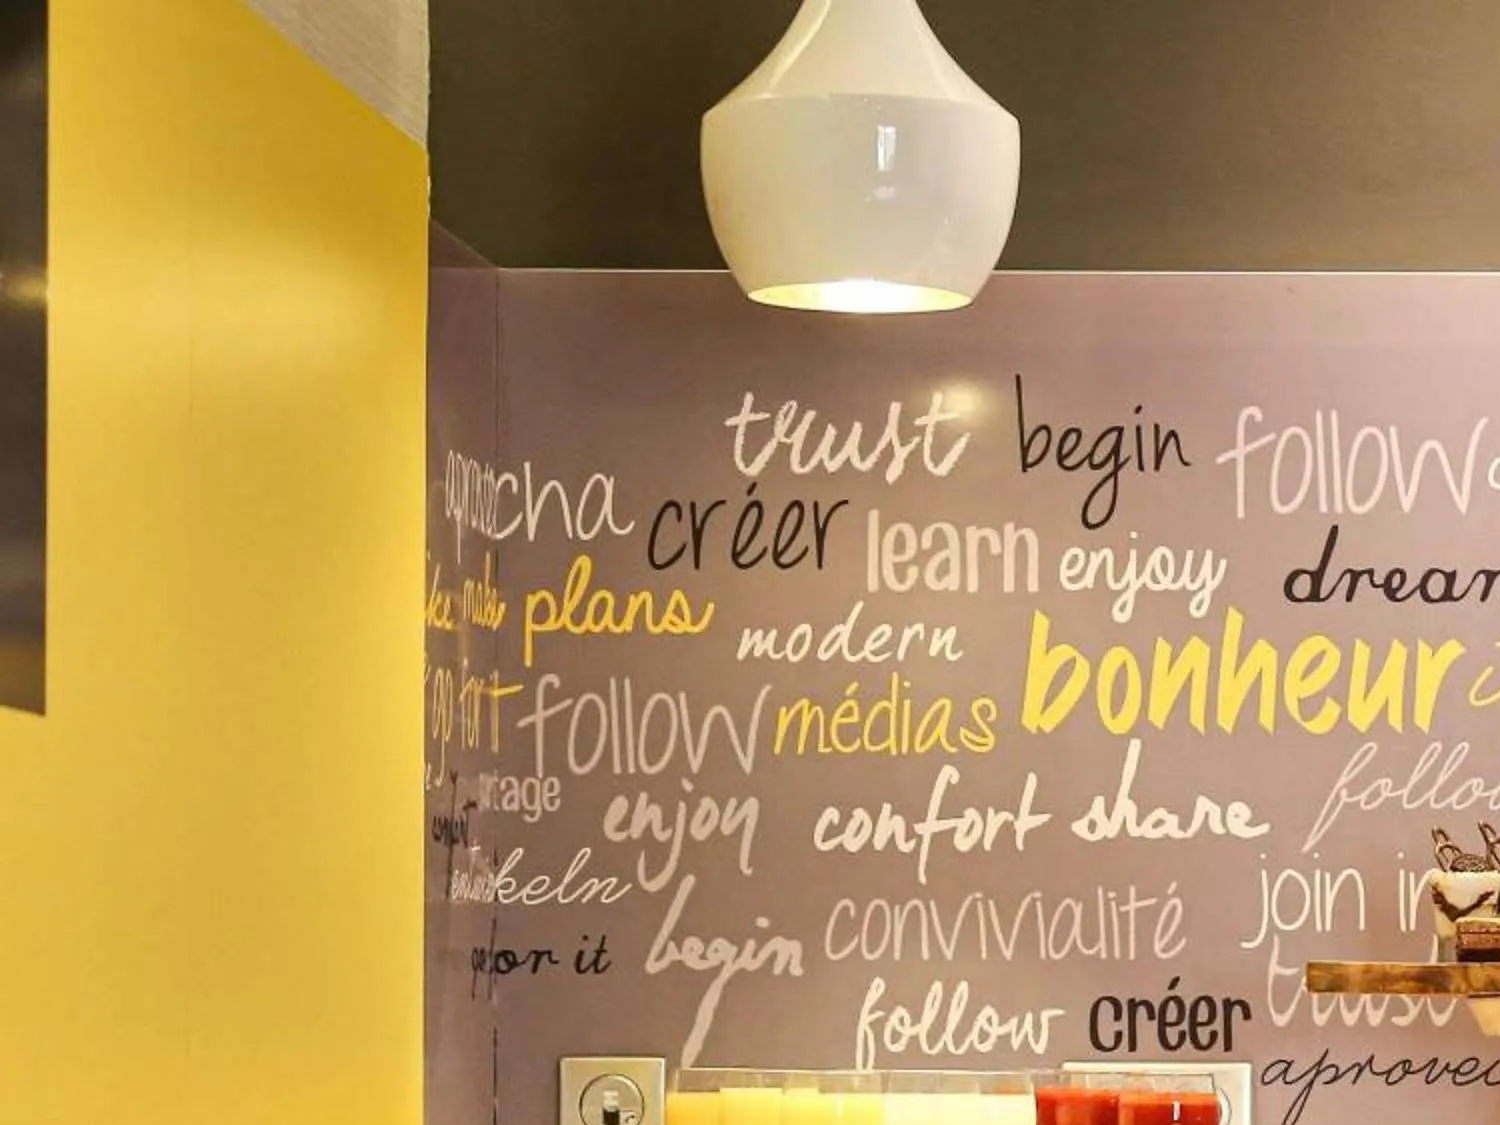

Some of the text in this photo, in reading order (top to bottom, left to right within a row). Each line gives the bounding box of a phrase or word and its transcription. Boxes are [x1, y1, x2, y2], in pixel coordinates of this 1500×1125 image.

[725, 392, 971, 483] trust
[1015, 373, 1192, 530] begin
[1216, 405, 1488, 519] follow
[646, 481, 849, 571] créer
[868, 509, 1039, 594] learn
[525, 554, 714, 668] plans
[1058, 531, 1228, 623] enjoy
[736, 601, 963, 664] modern
[1021, 606, 1467, 736] bonheur
[516, 673, 774, 778] follow
[772, 671, 997, 756] médias
[603, 779, 760, 892] enjoy
[813, 764, 1053, 884] confort
[1071, 738, 1272, 842] share
[823, 880, 1187, 961] convivialité
[1241, 853, 1365, 949] join
[574, 934, 612, 974] it
[644, 875, 804, 1069] begin
[856, 976, 1066, 1071] follow
[1089, 976, 1252, 1053] créer
